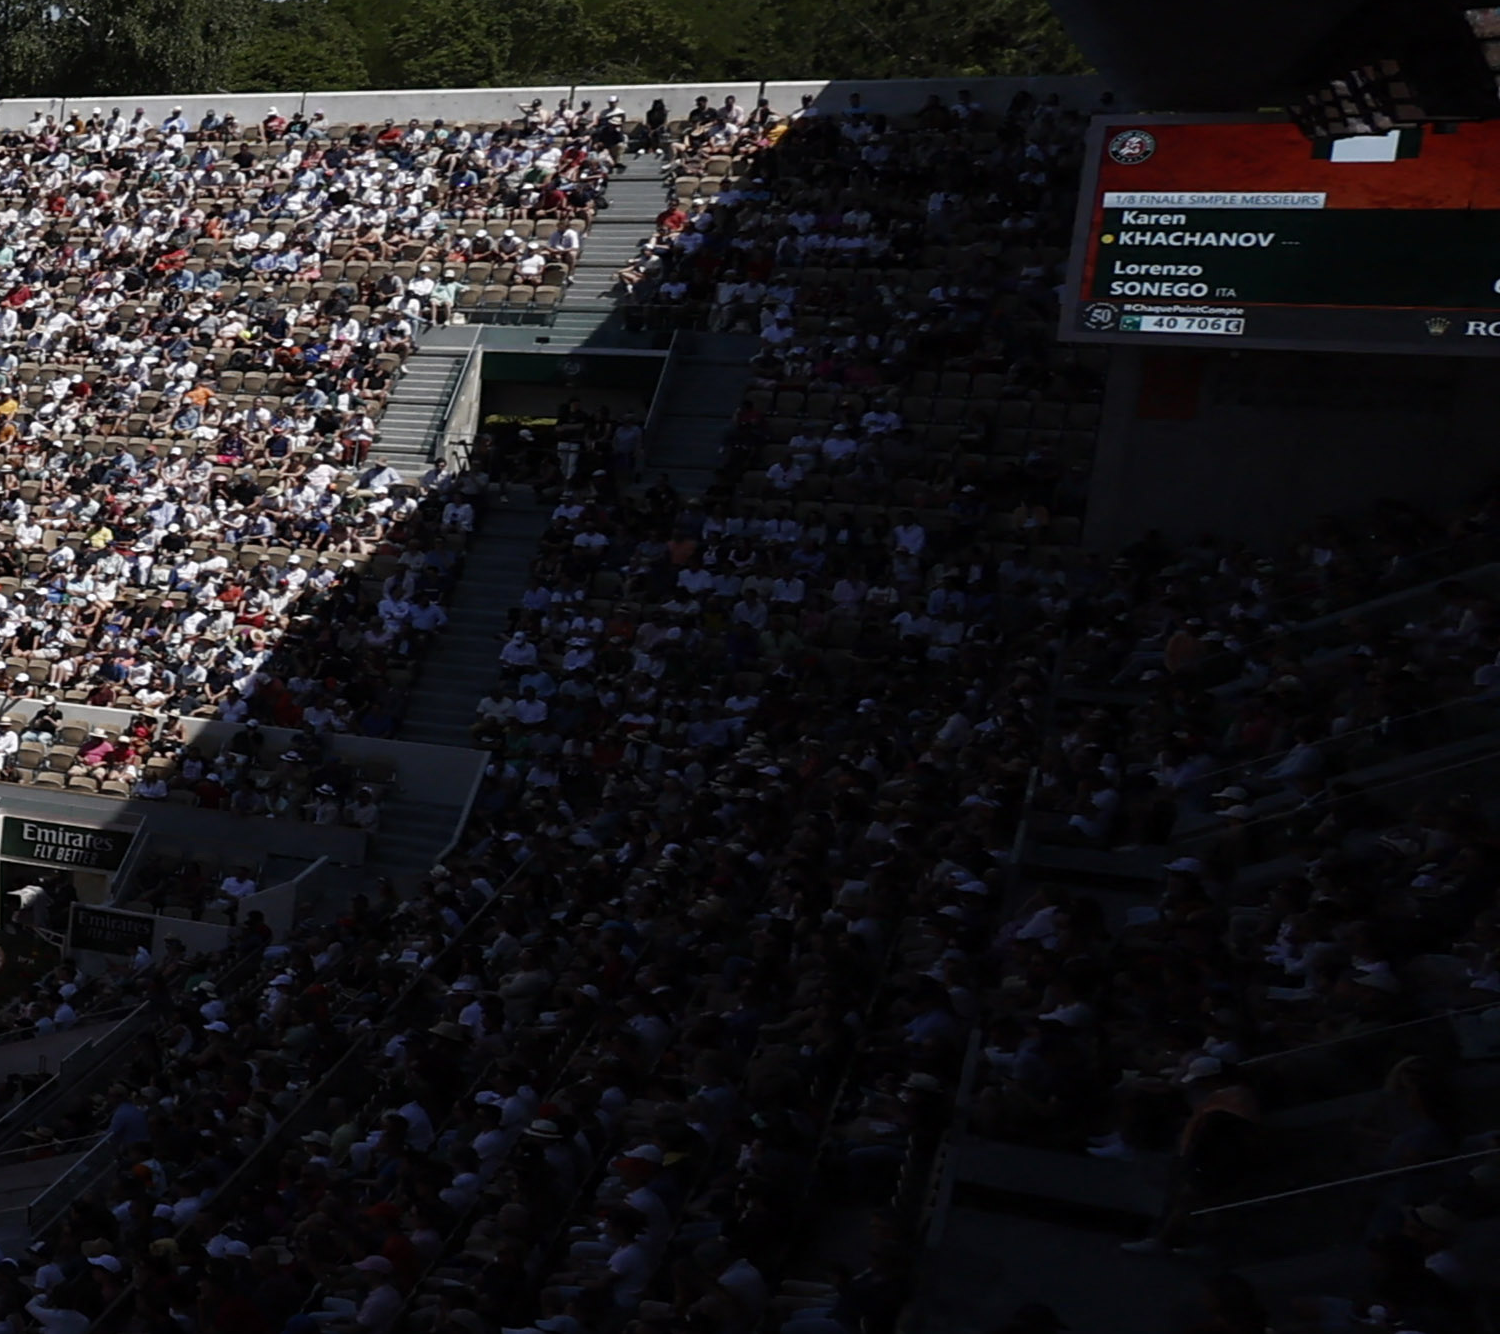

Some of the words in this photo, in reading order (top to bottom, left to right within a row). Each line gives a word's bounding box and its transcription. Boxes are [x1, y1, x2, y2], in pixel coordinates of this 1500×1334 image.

[1139, 194, 1185, 205] FINALE
[1188, 194, 1238, 205] SIMPLE
[1239, 194, 1320, 207] MESSIEURS
[1122, 210, 1187, 226] Karen
[1118, 231, 1275, 248] KHACHANOV
[1113, 260, 1204, 277] Lorenzo
[1109, 281, 1209, 298] SONEGO
[1215, 287, 1237, 299] ITA
[1152, 317, 1178, 330] 40
[1184, 317, 1222, 331] 706
[21, 821, 114, 852] Emirates
[33, 844, 53, 860] FLY
[56, 846, 99, 866] BETTER
